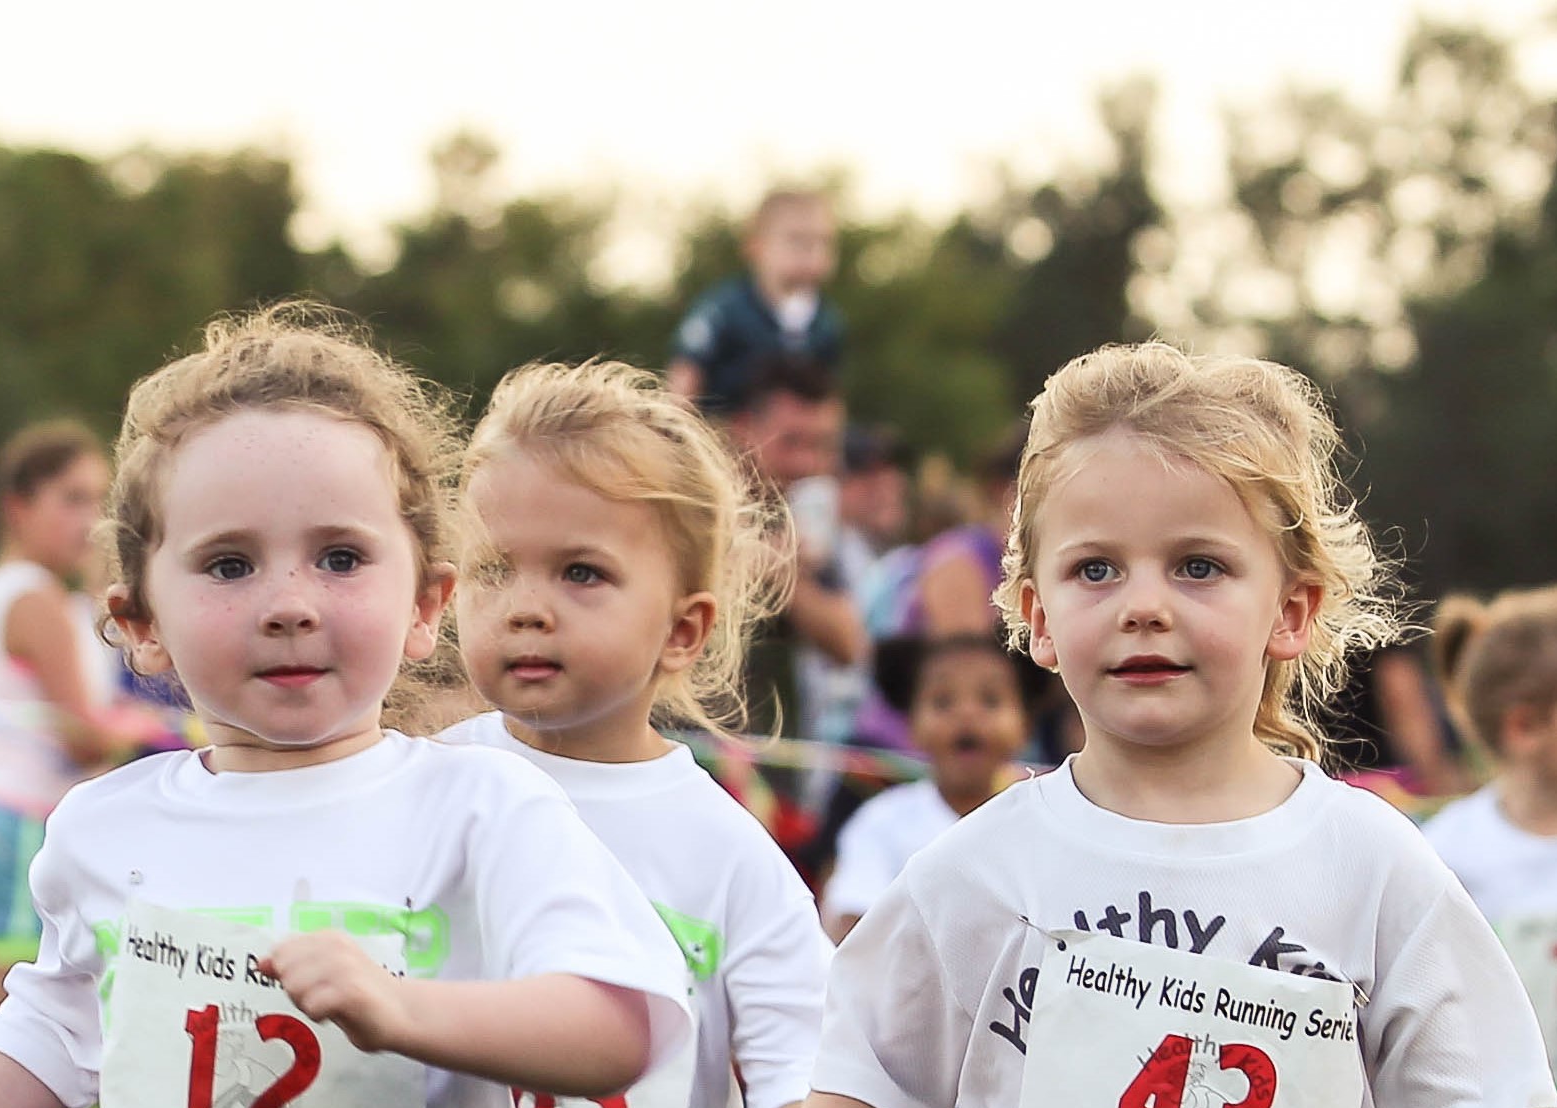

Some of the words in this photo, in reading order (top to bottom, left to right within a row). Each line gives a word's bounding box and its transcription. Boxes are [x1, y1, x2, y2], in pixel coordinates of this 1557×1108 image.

[128, 925, 188, 978] Healthy
[195, 942, 235, 981] Kids
[1067, 955, 1151, 1009] Healthy
[1159, 976, 1205, 1014] Kids
[1214, 988, 1297, 1041] Running
[1305, 1009, 1354, 1042] Serie
